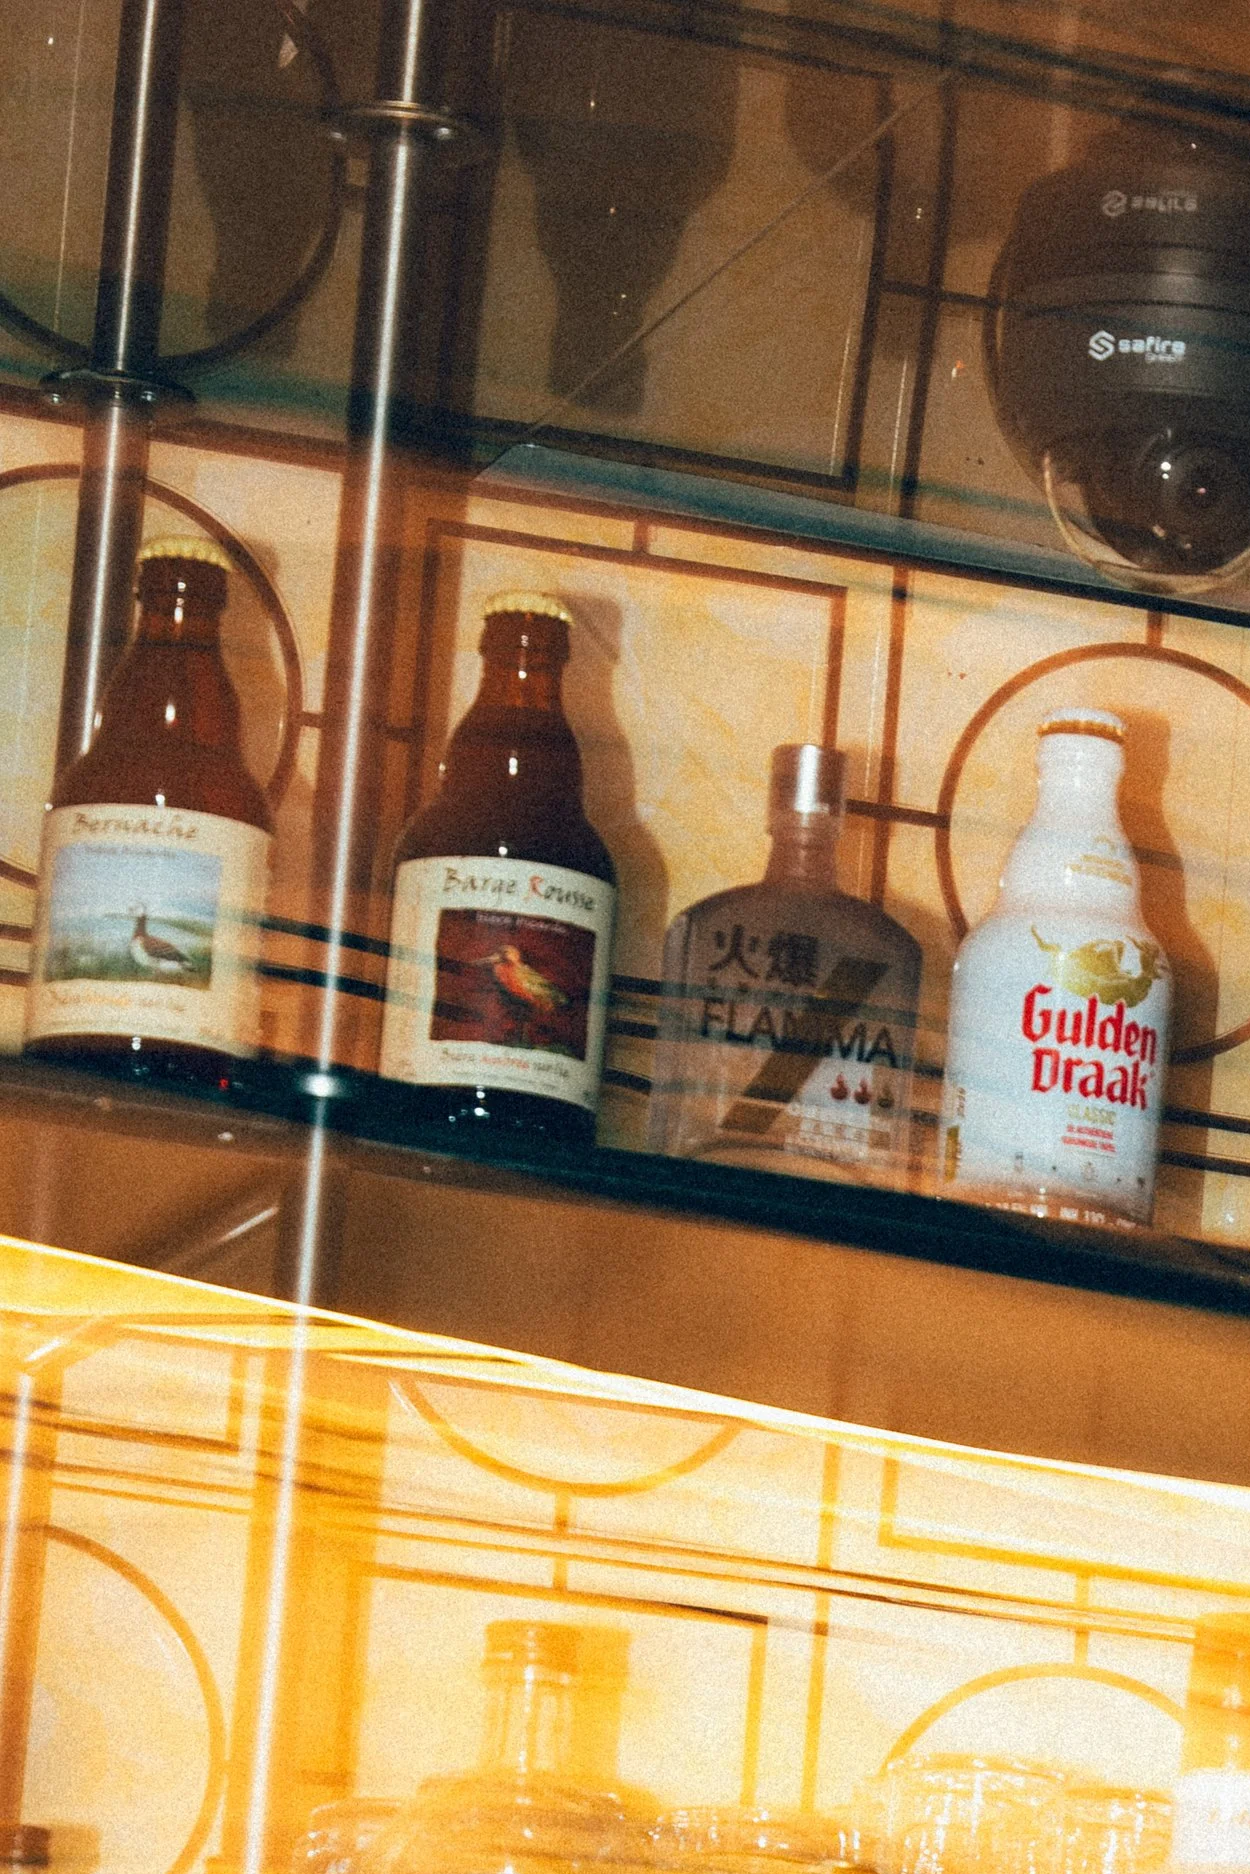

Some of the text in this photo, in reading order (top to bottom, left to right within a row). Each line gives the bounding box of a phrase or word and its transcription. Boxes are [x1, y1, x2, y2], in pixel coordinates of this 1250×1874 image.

[1118, 336, 1186, 354] safire
[526, 875, 597, 911] Rousse
[1021, 983, 1158, 1067] Gulden
[1031, 1046, 1149, 1112] Draak
